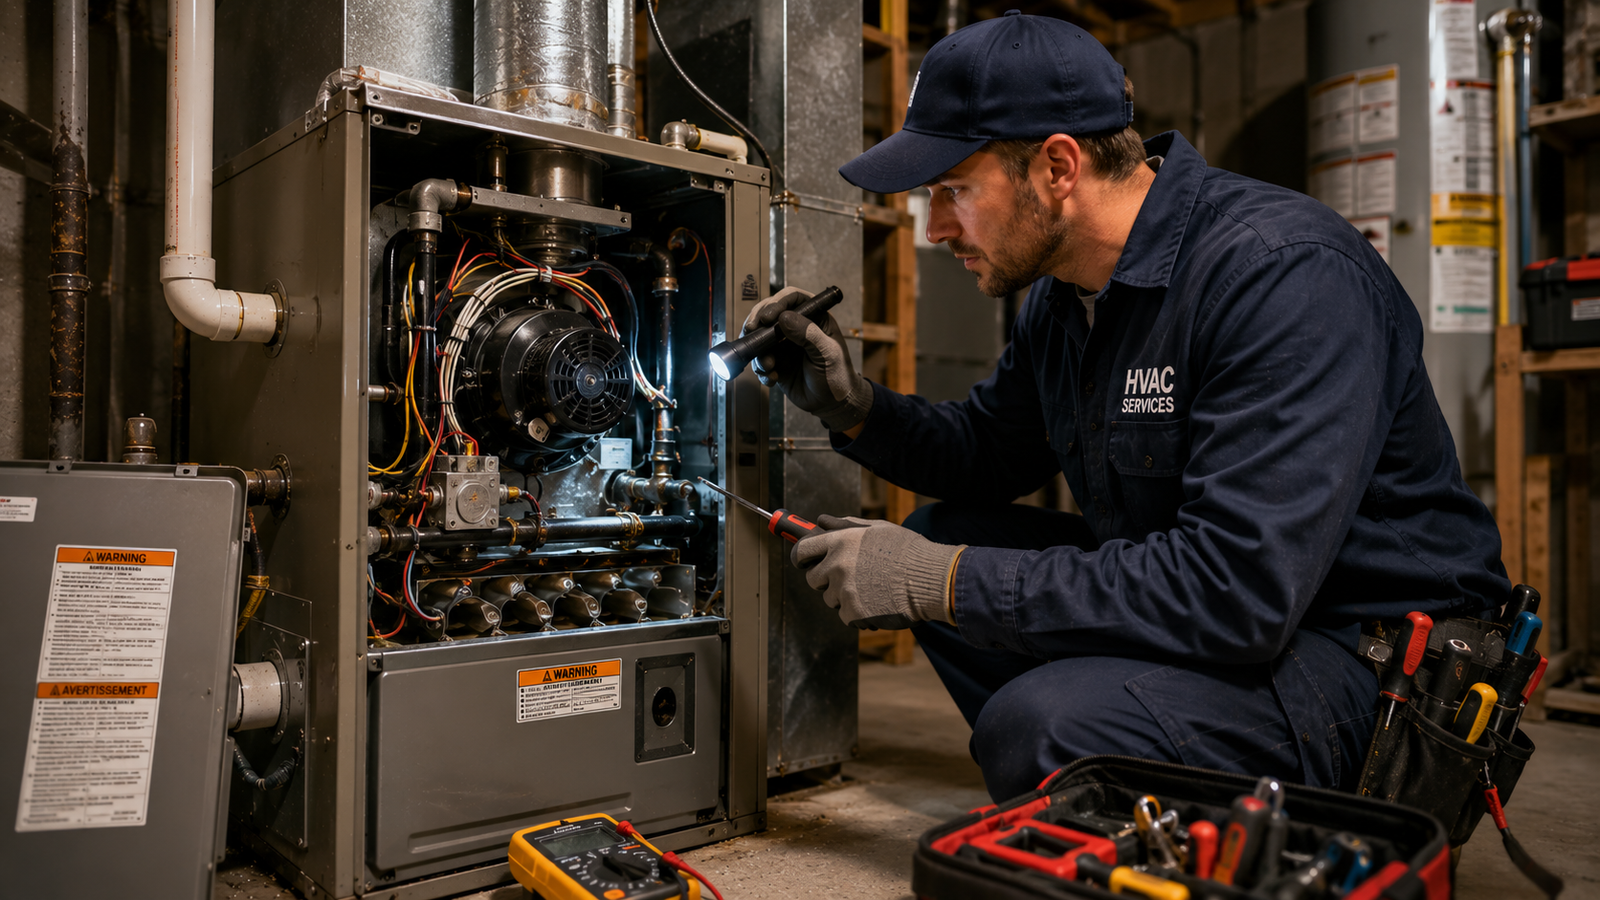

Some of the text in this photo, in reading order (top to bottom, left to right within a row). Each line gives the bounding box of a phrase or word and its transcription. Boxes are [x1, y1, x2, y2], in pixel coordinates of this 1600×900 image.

[1124, 366, 1175, 395] HVAC
[1121, 396, 1175, 413] SERVICES
[96, 552, 147, 563] WARNING
[553, 665, 598, 680] WARNING
[62, 685, 148, 696] AVERTISSEMENT
